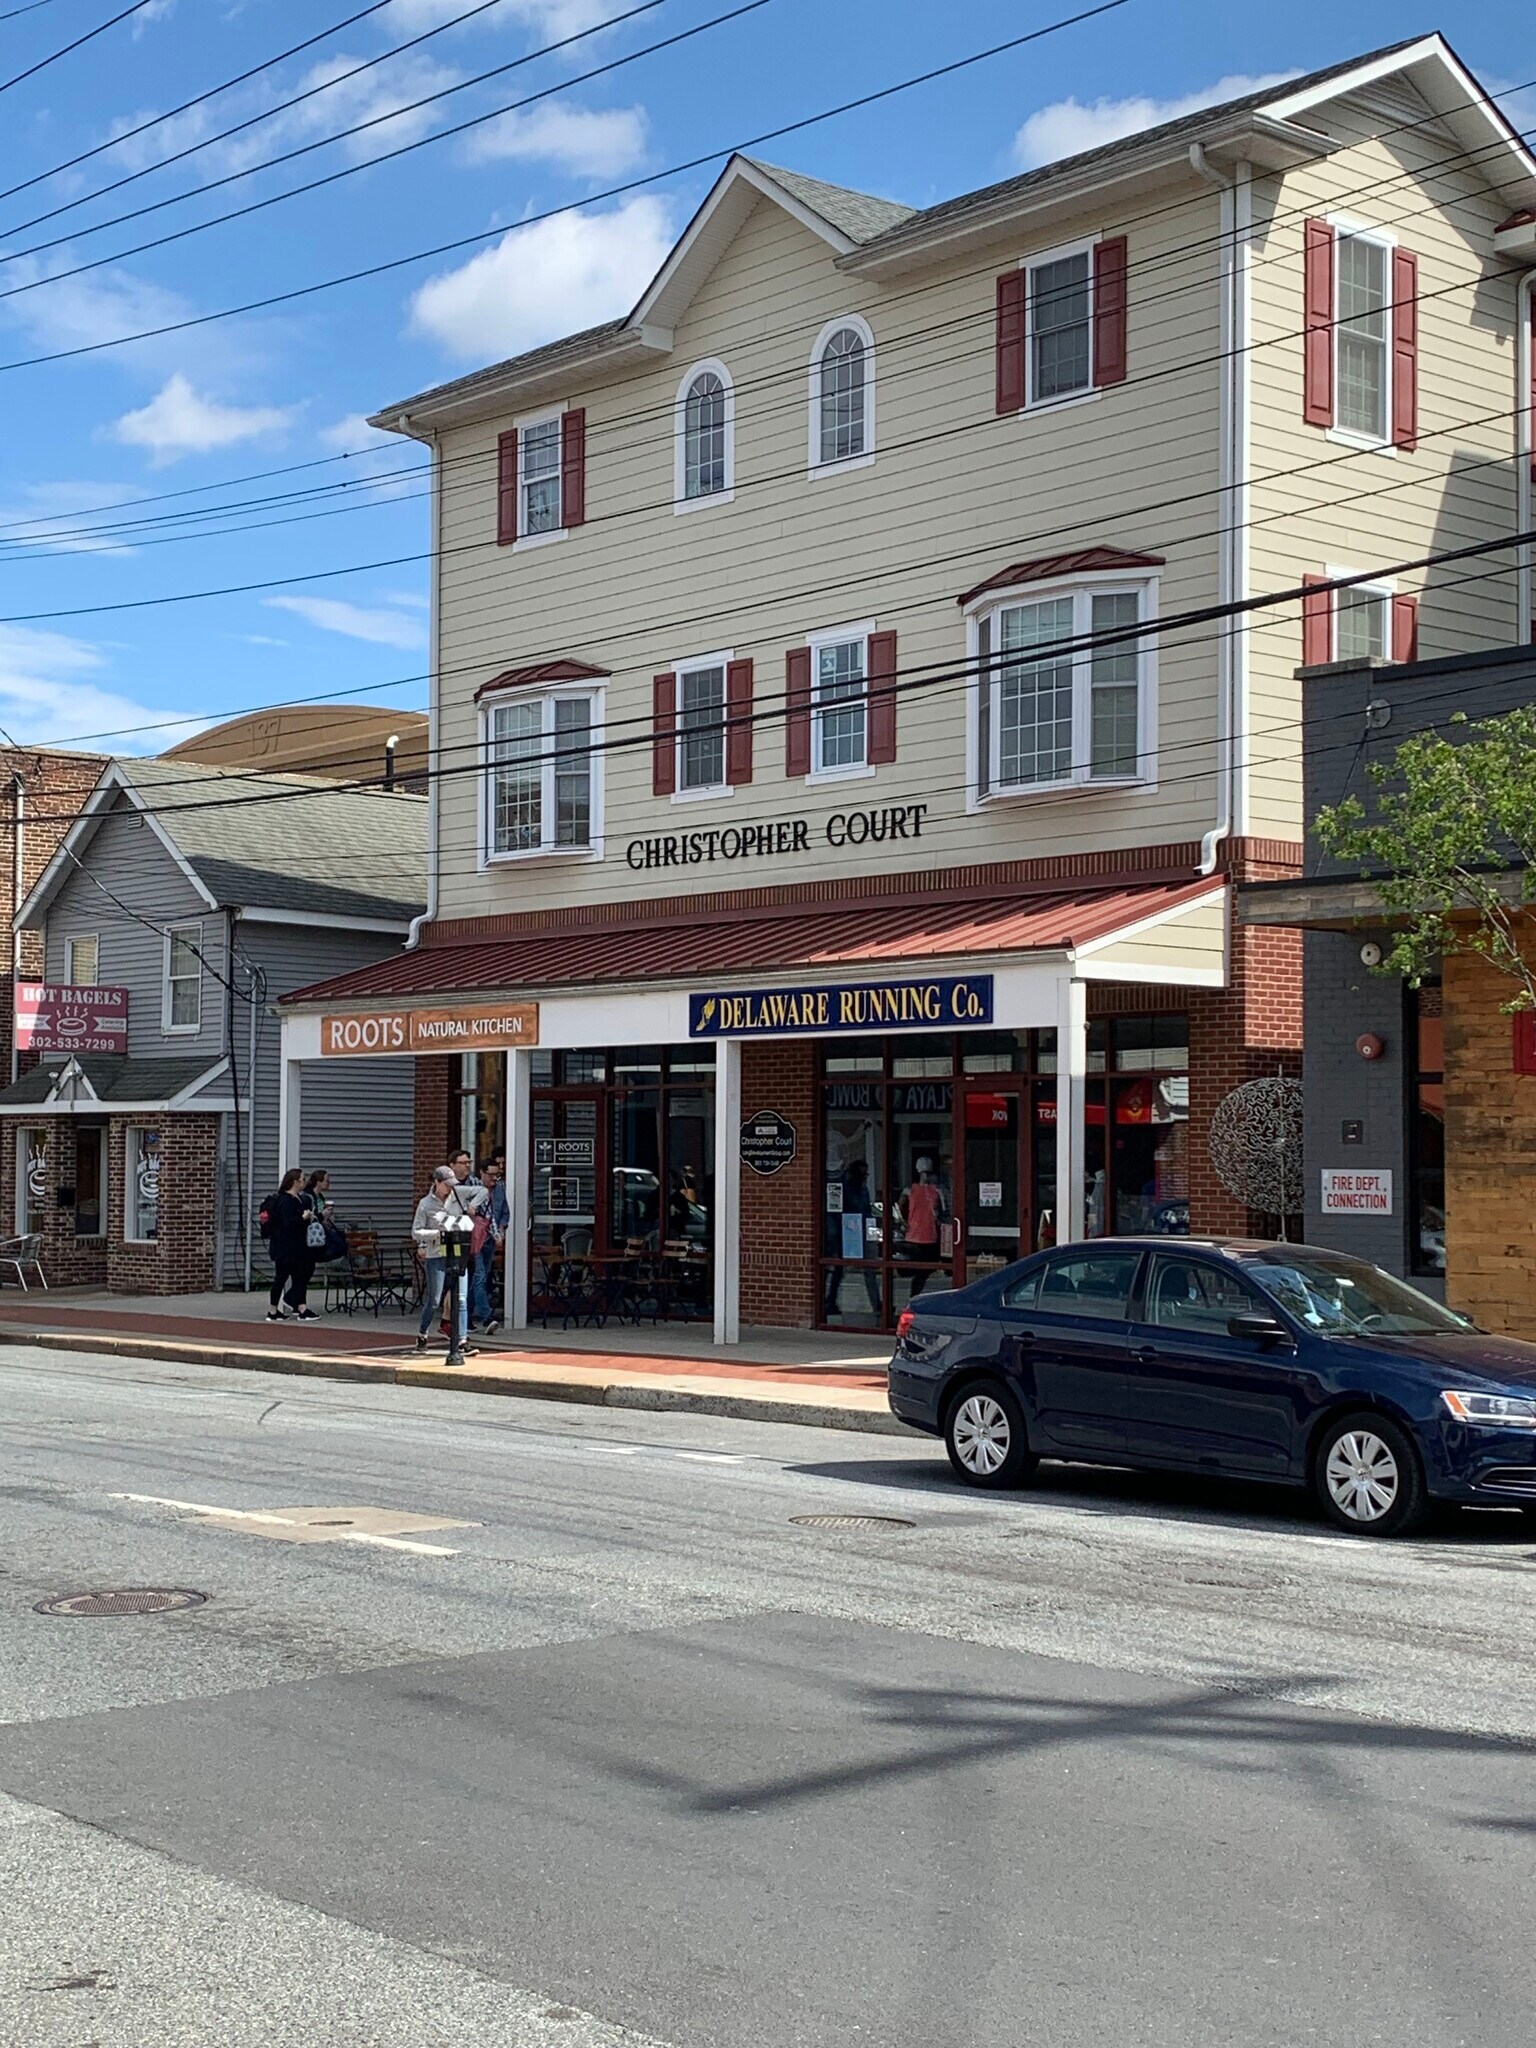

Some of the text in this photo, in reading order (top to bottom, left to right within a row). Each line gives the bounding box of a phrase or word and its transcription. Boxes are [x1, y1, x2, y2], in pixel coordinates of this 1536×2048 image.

[626, 804, 927, 870] CHRISTOPHER COURT
[22, 987, 122, 1006] HOT BAGELS
[719, 983, 984, 1031] DELAWARE RUNNING Co.
[331, 1017, 522, 1049] ROOTS NATURAL KITCHEN
[28, 1036, 115, 1050] 302-533-7299
[558, 1142, 590, 1151] ROOTS
[741, 1136, 792, 1147] Christopher Court
[1332, 1175, 1353, 1190] FIRE
[1326, 1193, 1387, 1209] CONNECTION
